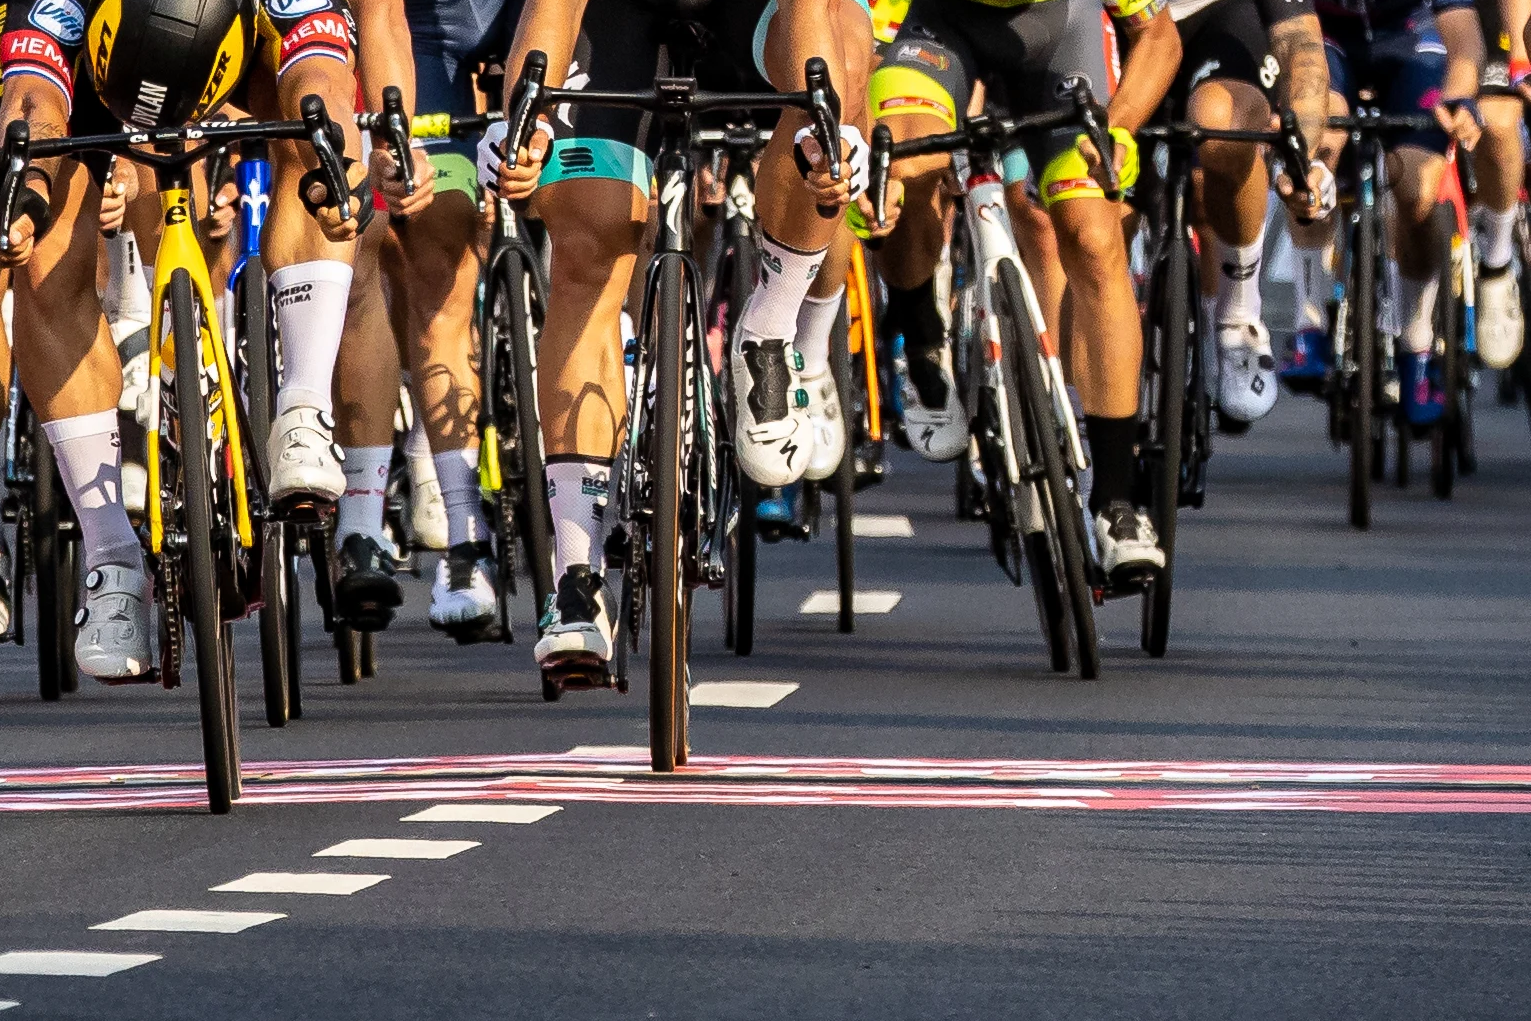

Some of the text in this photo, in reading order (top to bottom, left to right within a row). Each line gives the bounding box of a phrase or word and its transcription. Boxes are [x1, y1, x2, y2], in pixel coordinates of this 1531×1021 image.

[282, 19, 348, 51] HEMA
[131, 80, 168, 127] DYLAN
[279, 292, 312, 308] VISMA
